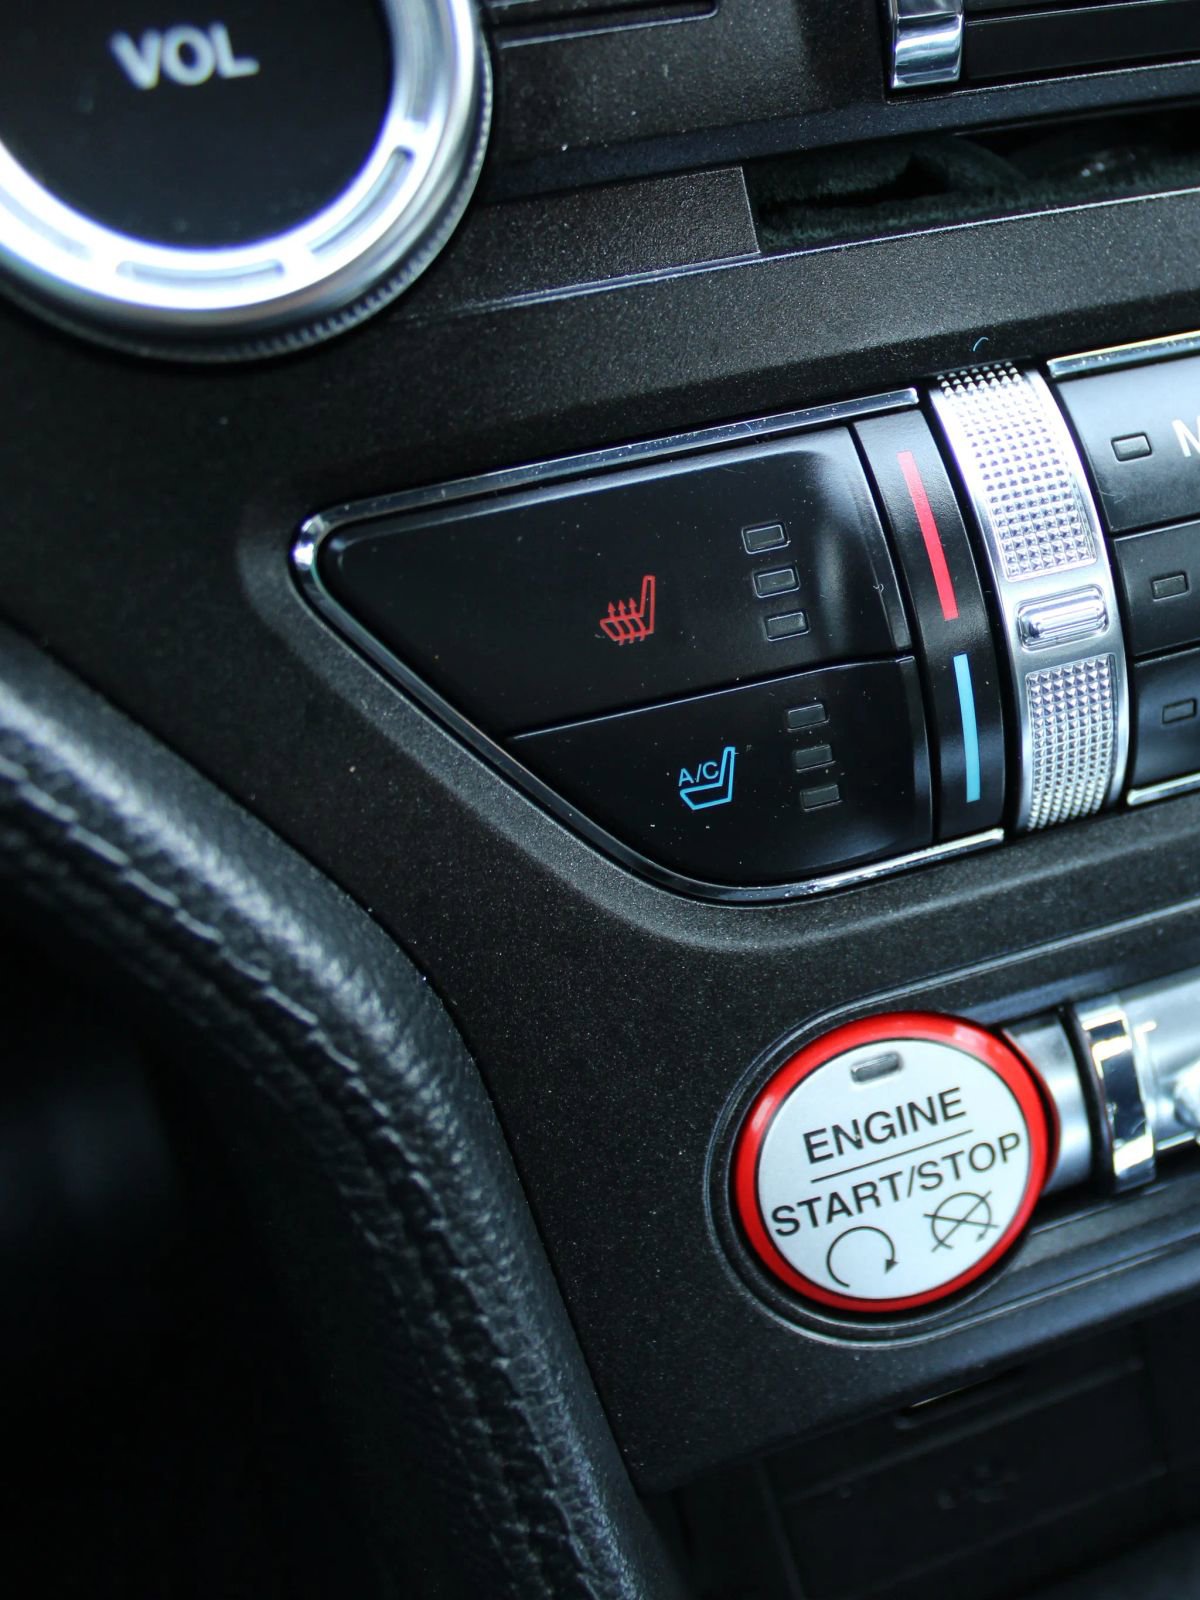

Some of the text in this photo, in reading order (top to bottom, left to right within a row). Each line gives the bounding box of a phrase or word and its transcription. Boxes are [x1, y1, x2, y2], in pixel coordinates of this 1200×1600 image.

[111, 24, 259, 89] VOL
[678, 761, 719, 786] A/C
[803, 1087, 966, 1164] ENGINE
[772, 1132, 1020, 1236] START/STOP
